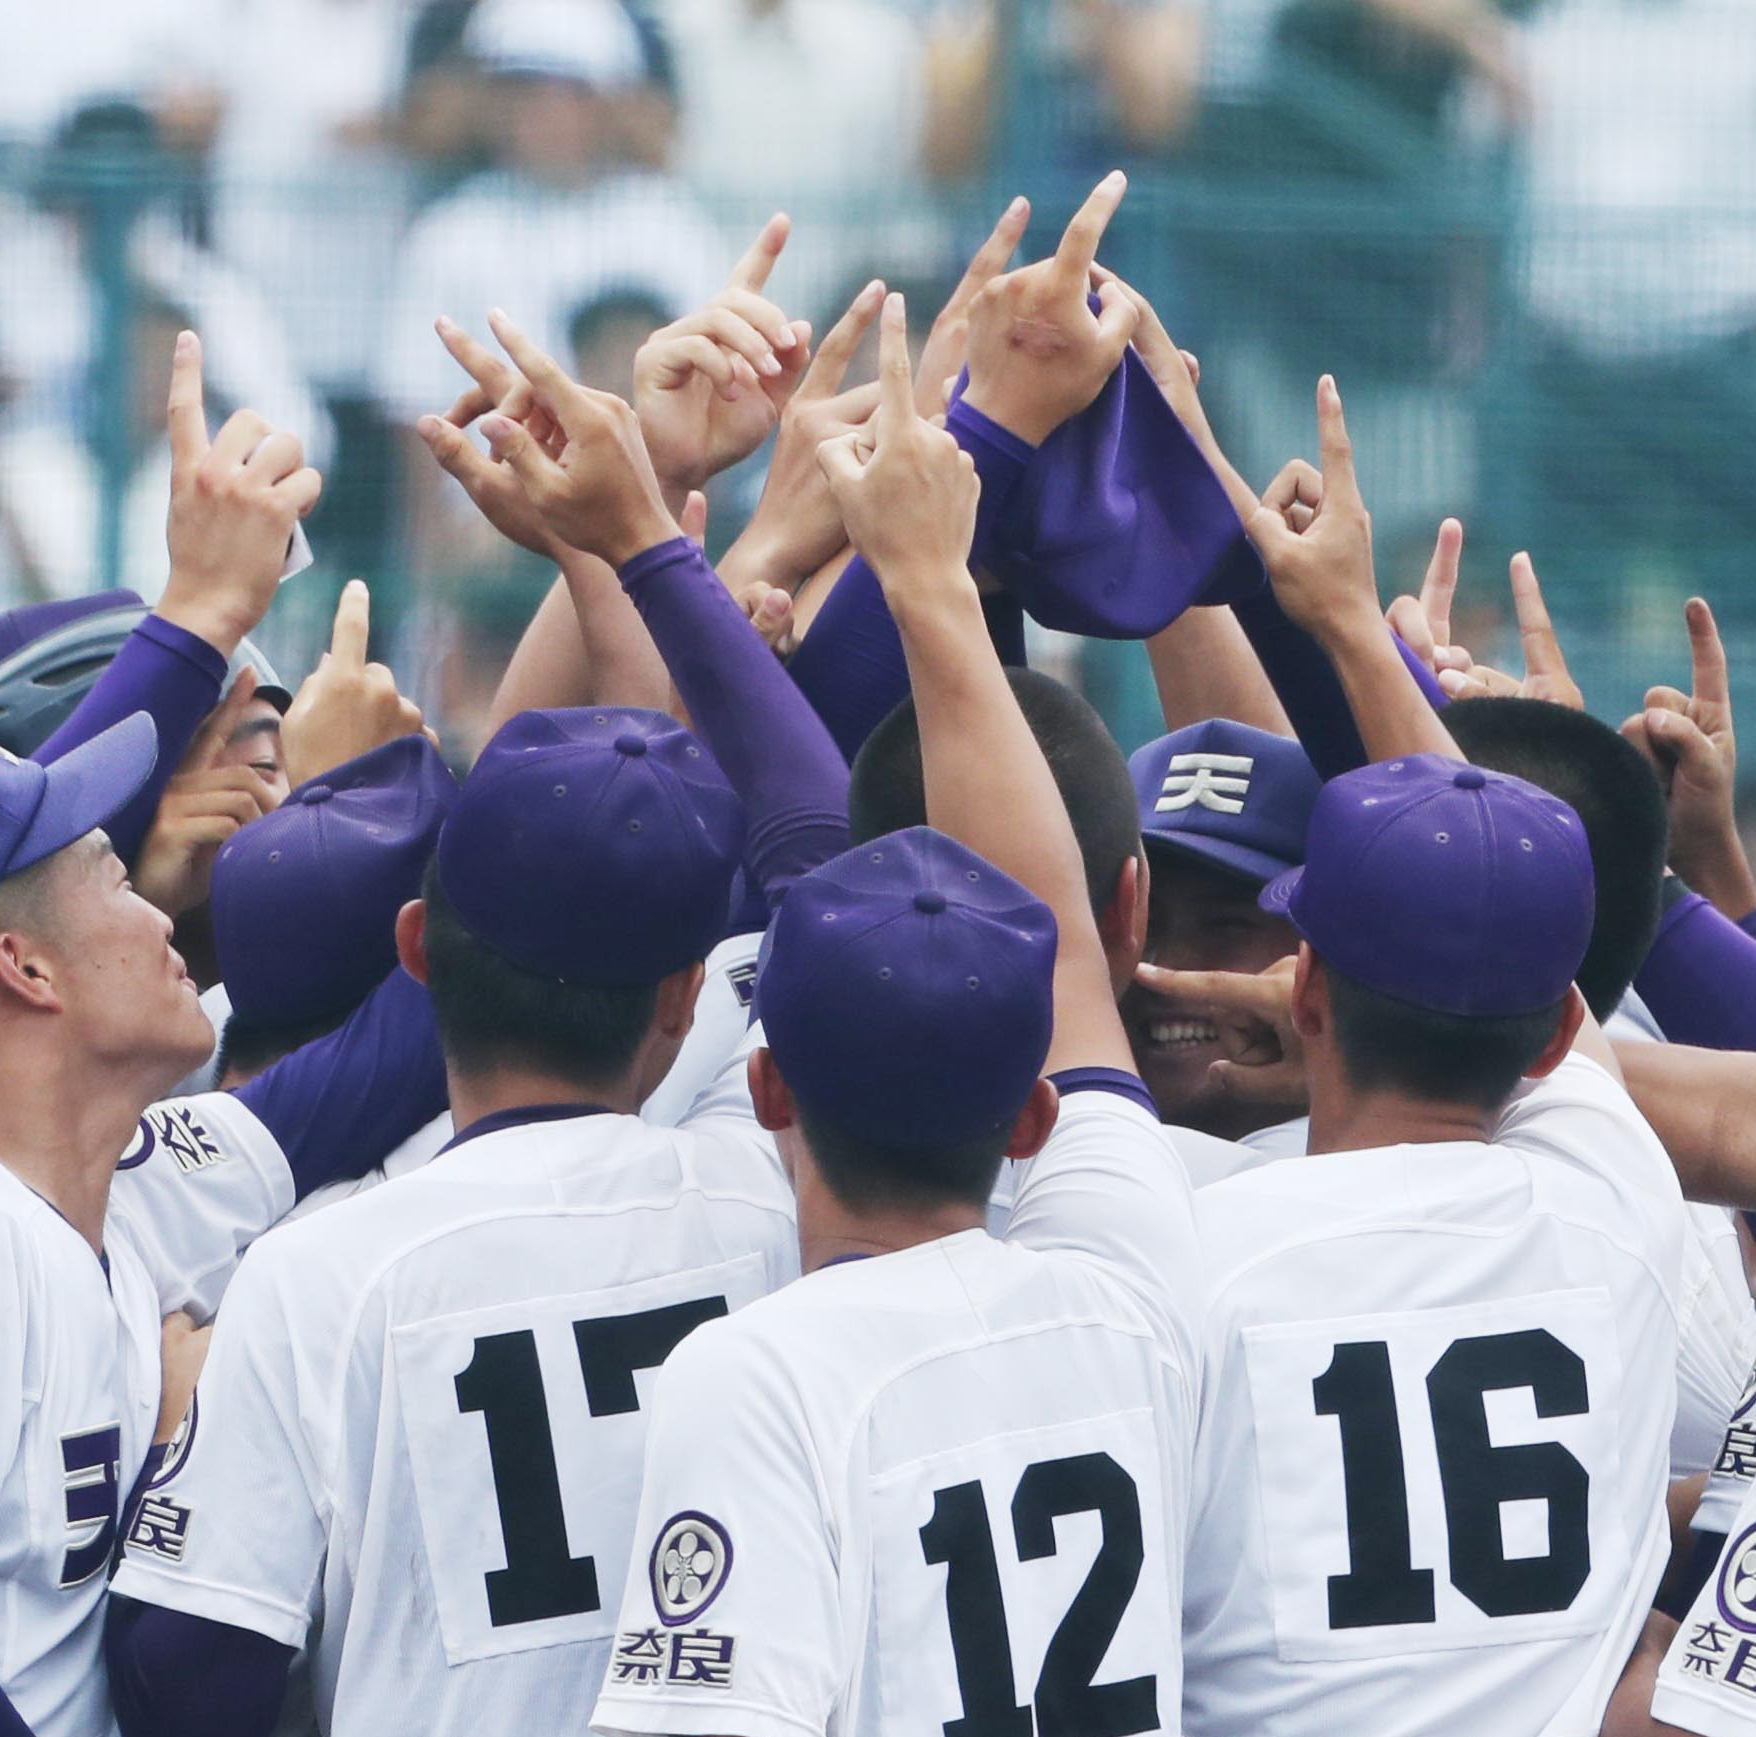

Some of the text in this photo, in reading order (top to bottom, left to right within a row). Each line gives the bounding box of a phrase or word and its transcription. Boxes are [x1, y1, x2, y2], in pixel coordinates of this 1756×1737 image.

[1154, 752, 1254, 815] 天
[1313, 1327, 1592, 1630] 16
[612, 1627, 738, 1688] 奈良
